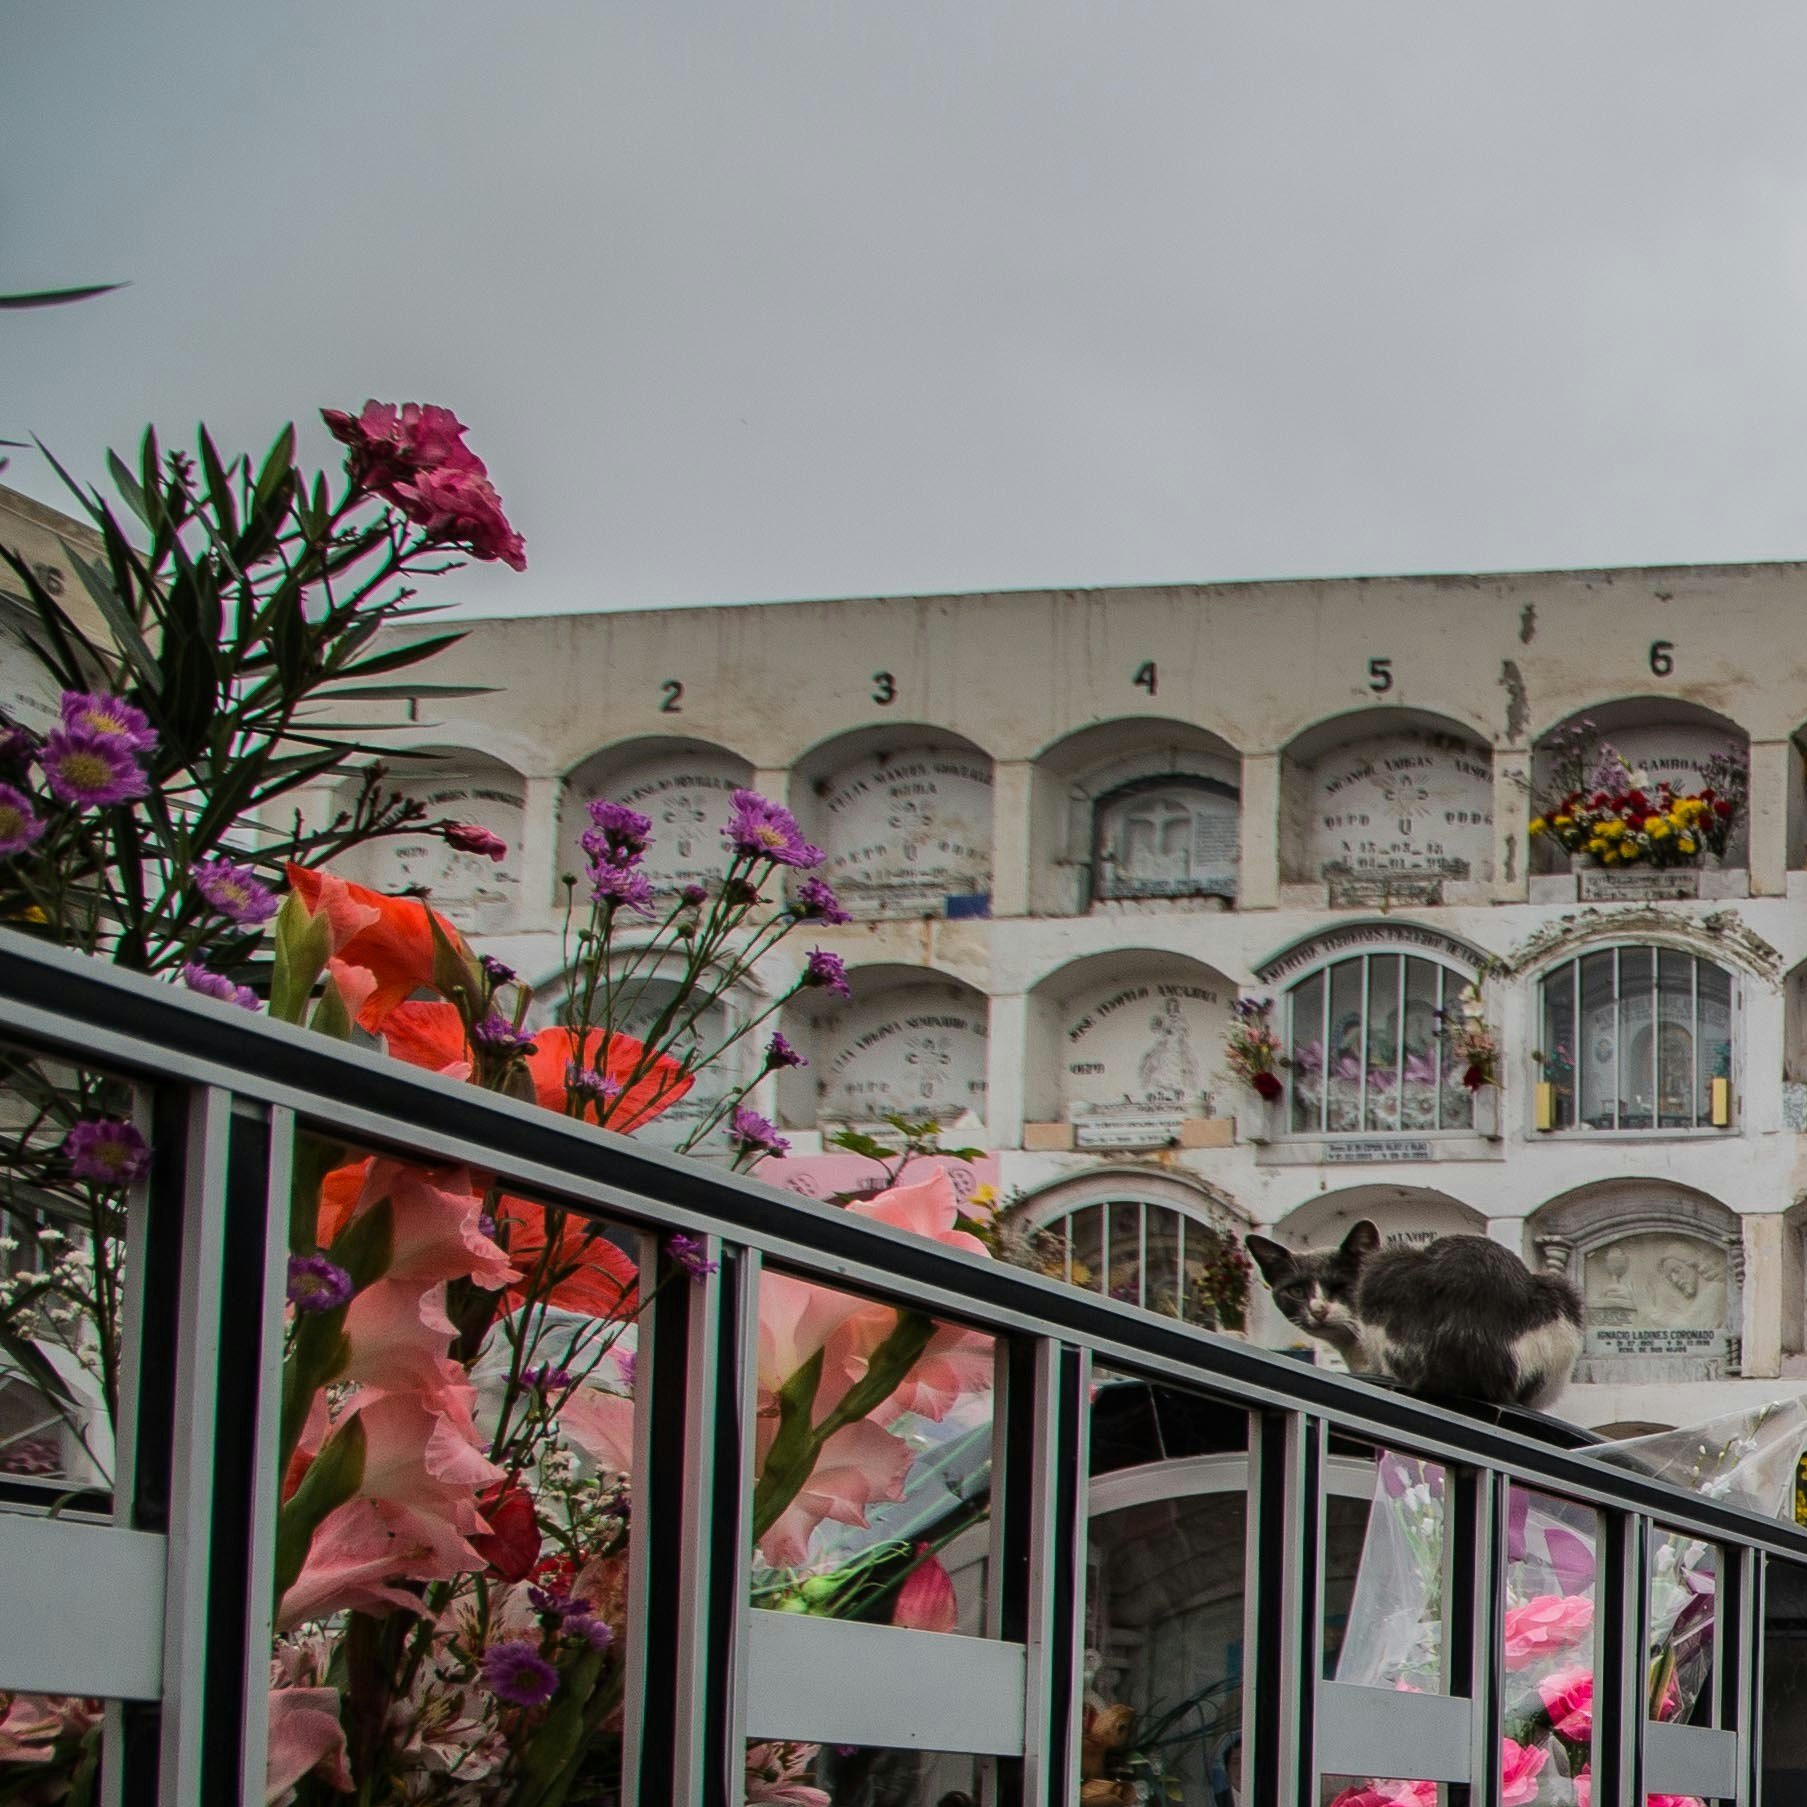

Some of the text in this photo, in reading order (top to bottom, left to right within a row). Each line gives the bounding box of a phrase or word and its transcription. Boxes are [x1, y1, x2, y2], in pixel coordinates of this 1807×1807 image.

[1368, 658, 1393, 693] 5
[1649, 640, 1675, 677] 6
[871, 671, 898, 705] 3
[1133, 660, 1158, 696] 4
[661, 680, 683, 714] 2
